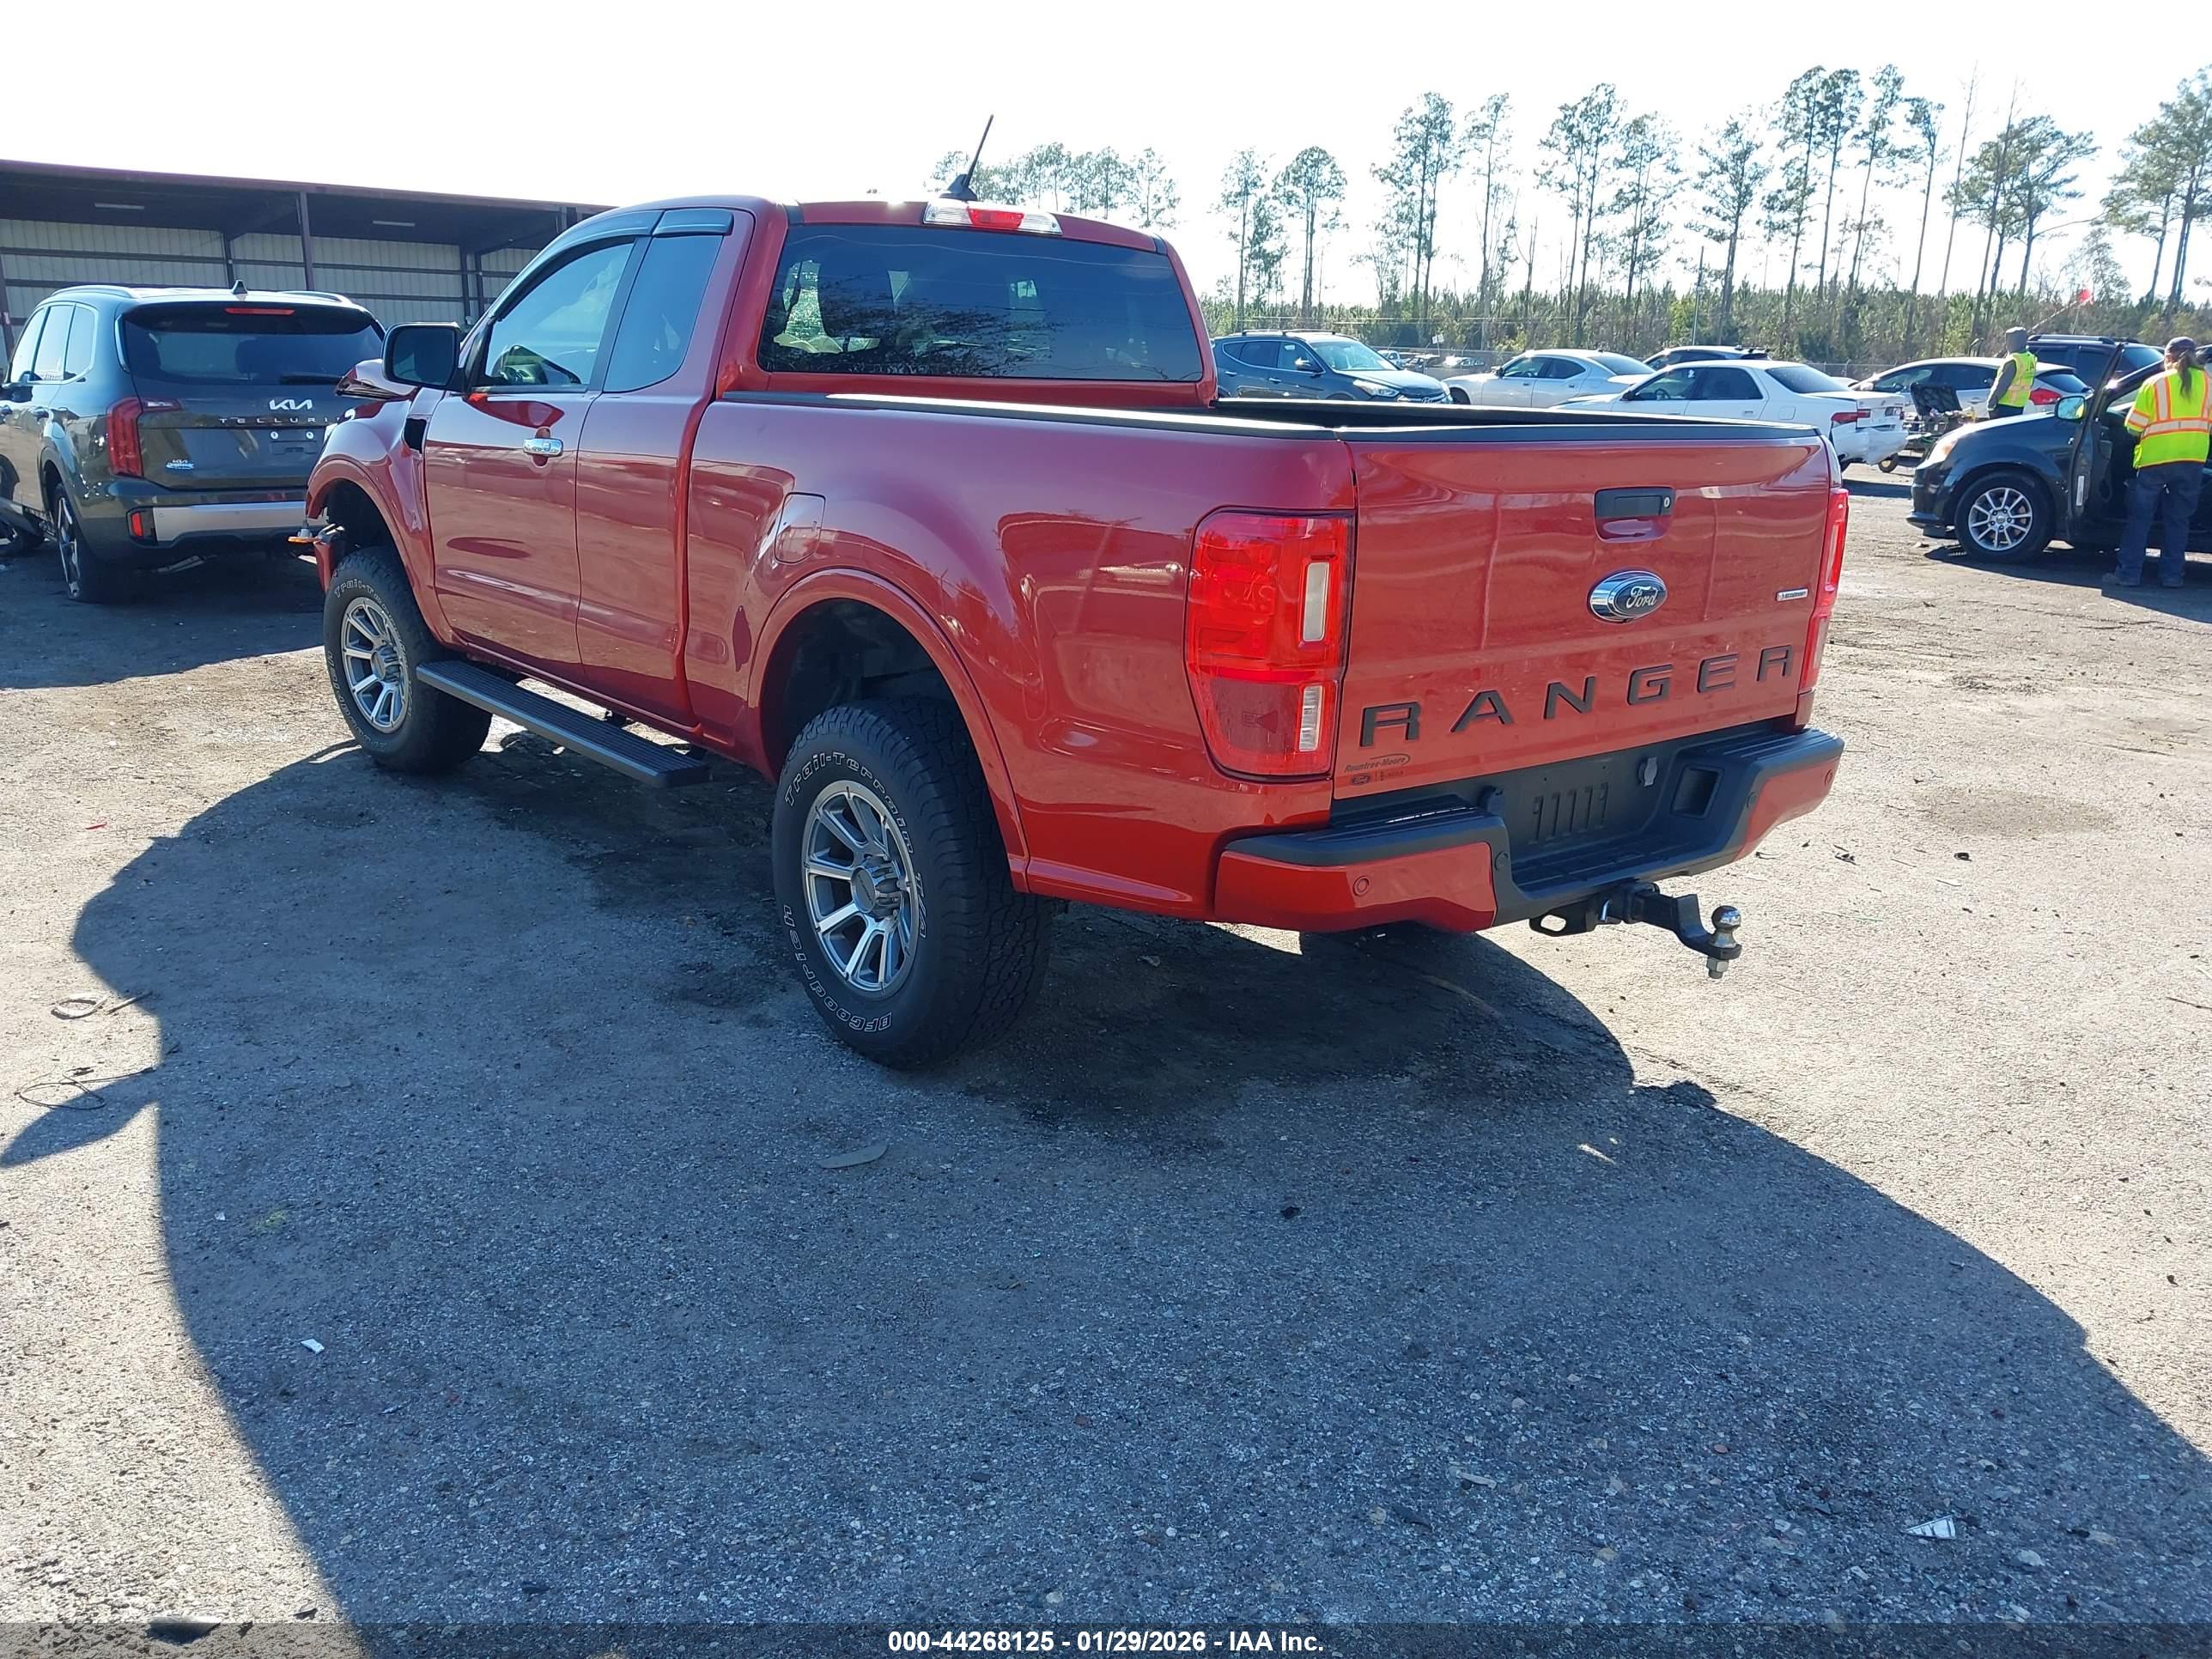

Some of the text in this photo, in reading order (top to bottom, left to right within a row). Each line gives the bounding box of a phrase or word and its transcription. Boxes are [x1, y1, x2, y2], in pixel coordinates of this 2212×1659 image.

[1626, 585, 1659, 609] Ford
[1359, 644, 1794, 748] RANGER
[783, 904, 892, 1032] BFGoodrich
